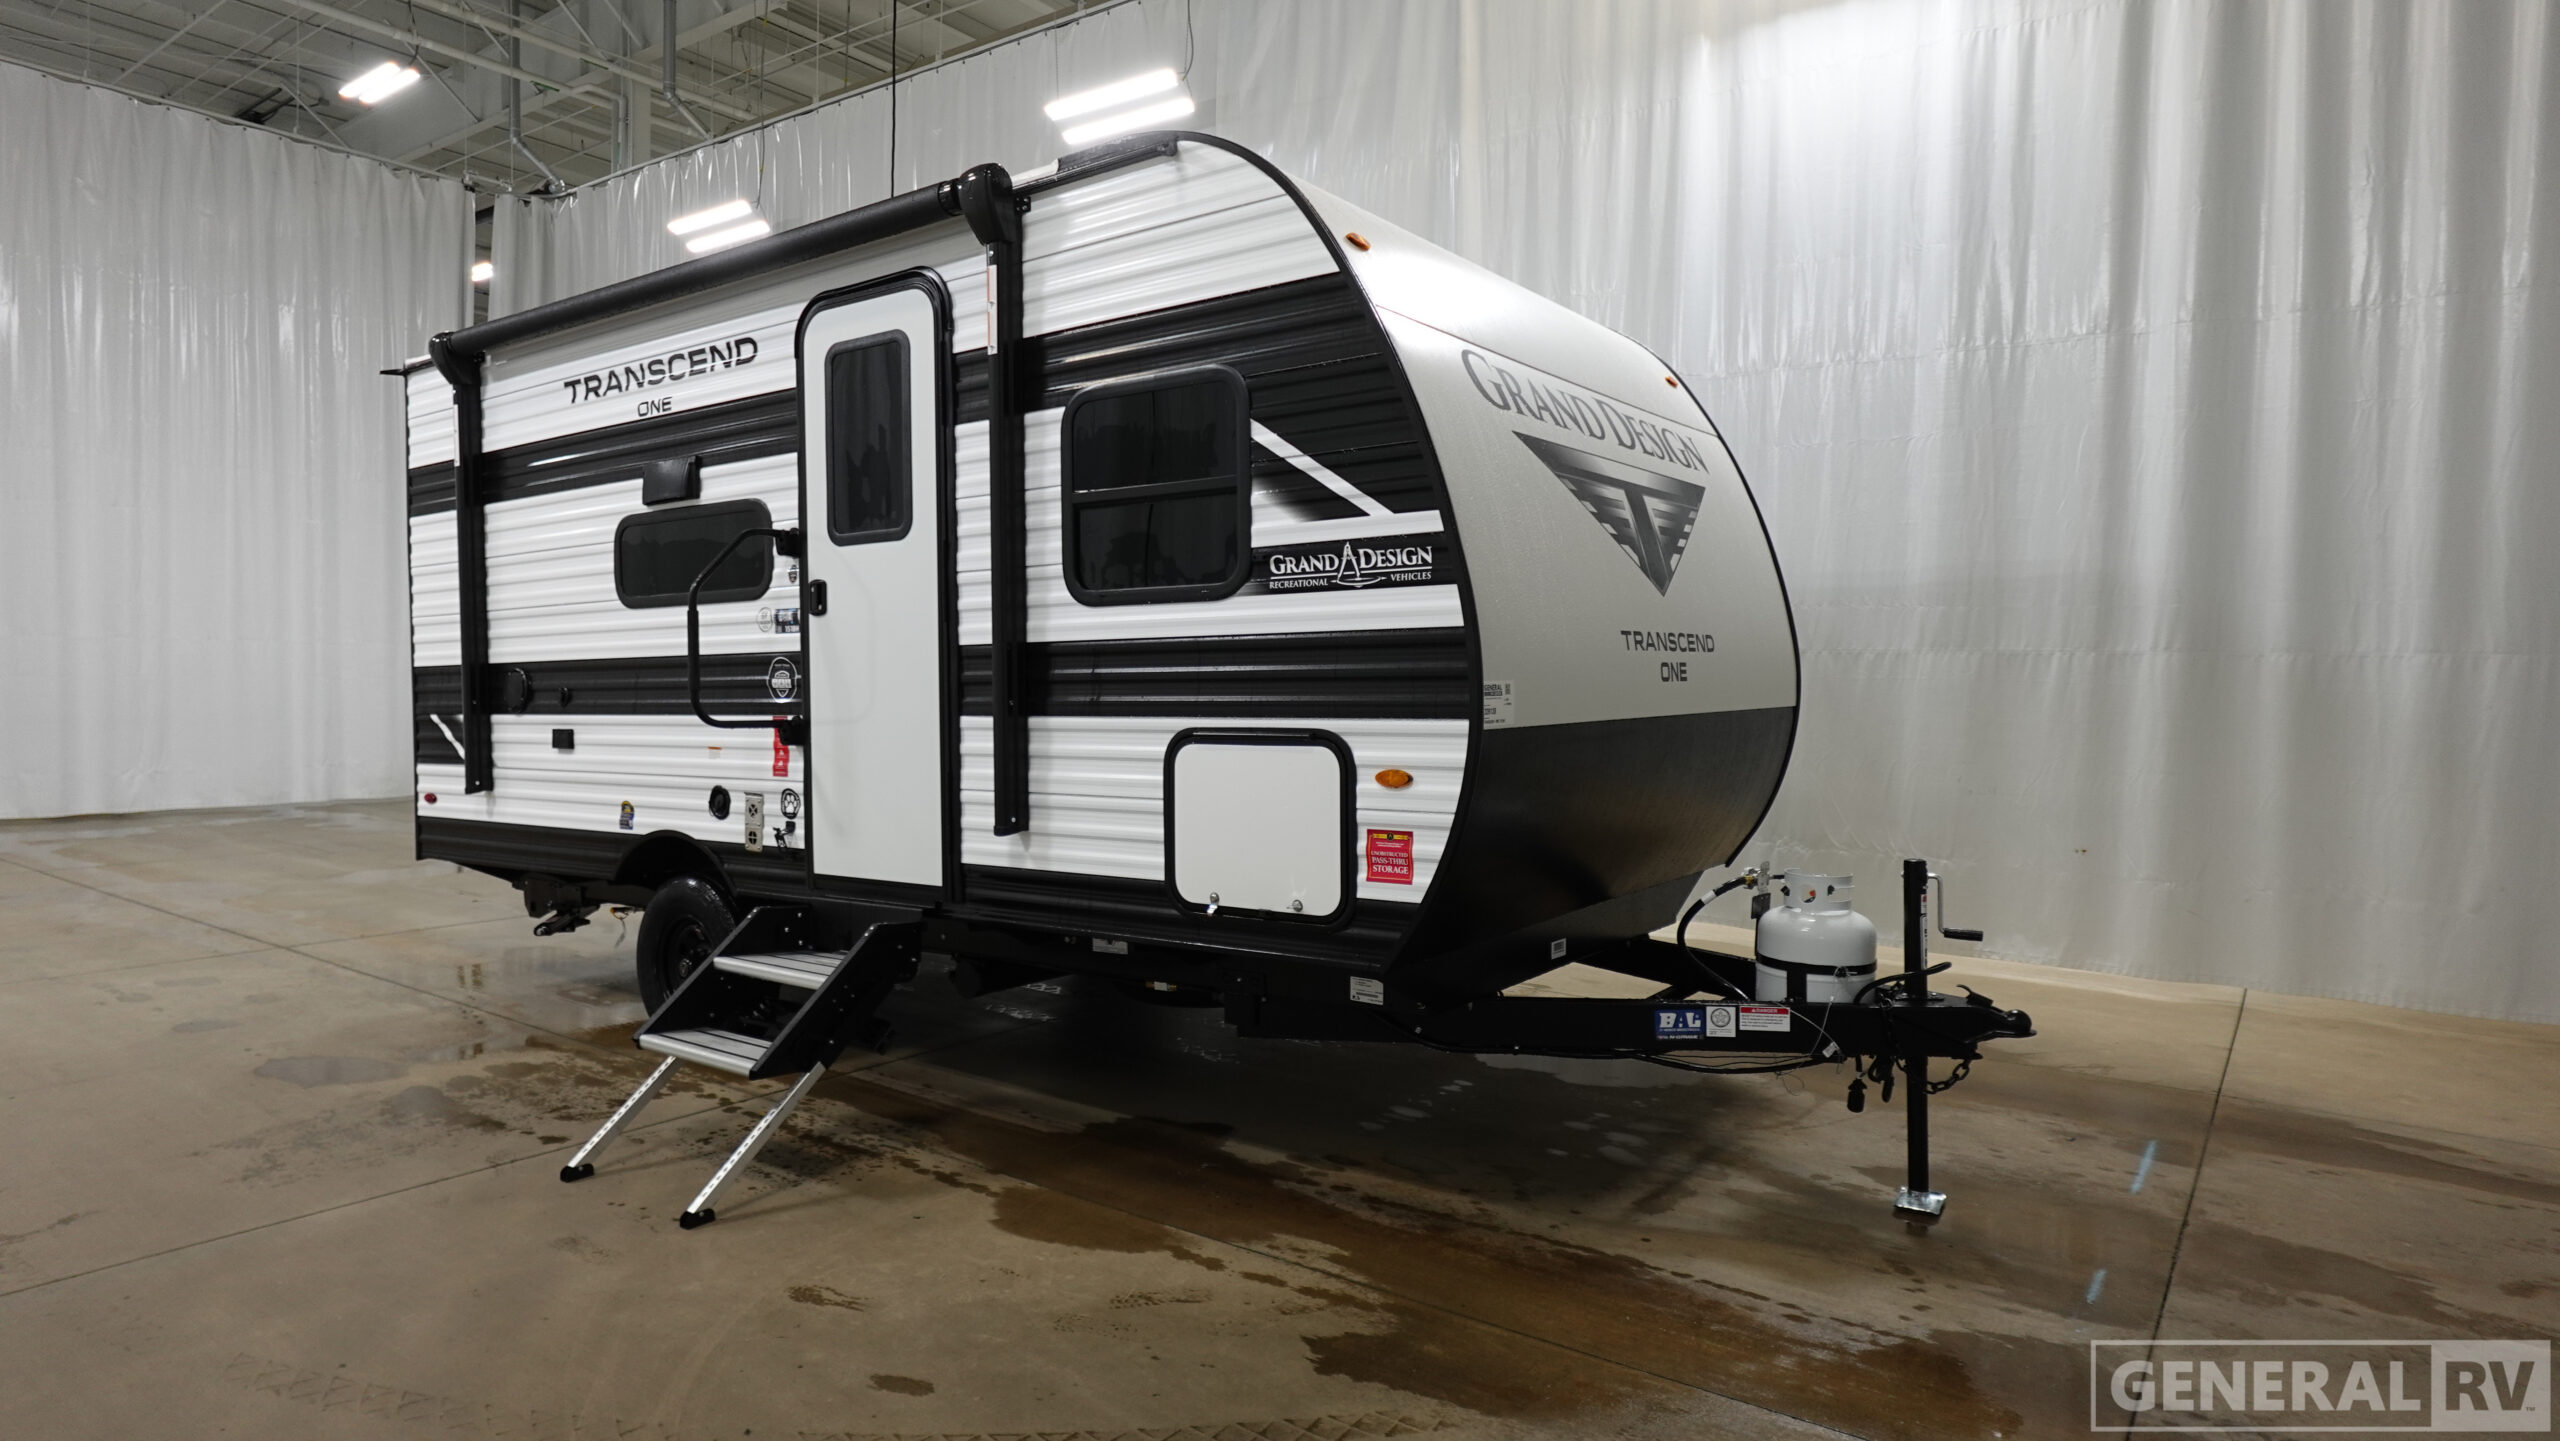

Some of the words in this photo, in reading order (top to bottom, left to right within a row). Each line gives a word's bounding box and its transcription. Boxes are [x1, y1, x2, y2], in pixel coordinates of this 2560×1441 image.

[564, 336, 758, 403] TRANSCEND
[637, 396, 673, 418] ONE
[1462, 349, 1606, 441] GRAND
[1591, 397, 1710, 475] DESIGN
[1269, 553, 1340, 575] GRAND
[1357, 546, 1433, 569] DESIGN
[1269, 578, 1329, 590] RECREATIONAL
[1390, 571, 1432, 582] VEHICLES
[1620, 630, 1715, 653] TRANSCEND
[1660, 662, 1688, 682] ONE
[1371, 857, 1408, 865] PASS-THRU
[1373, 865, 1409, 874] STORAGE
